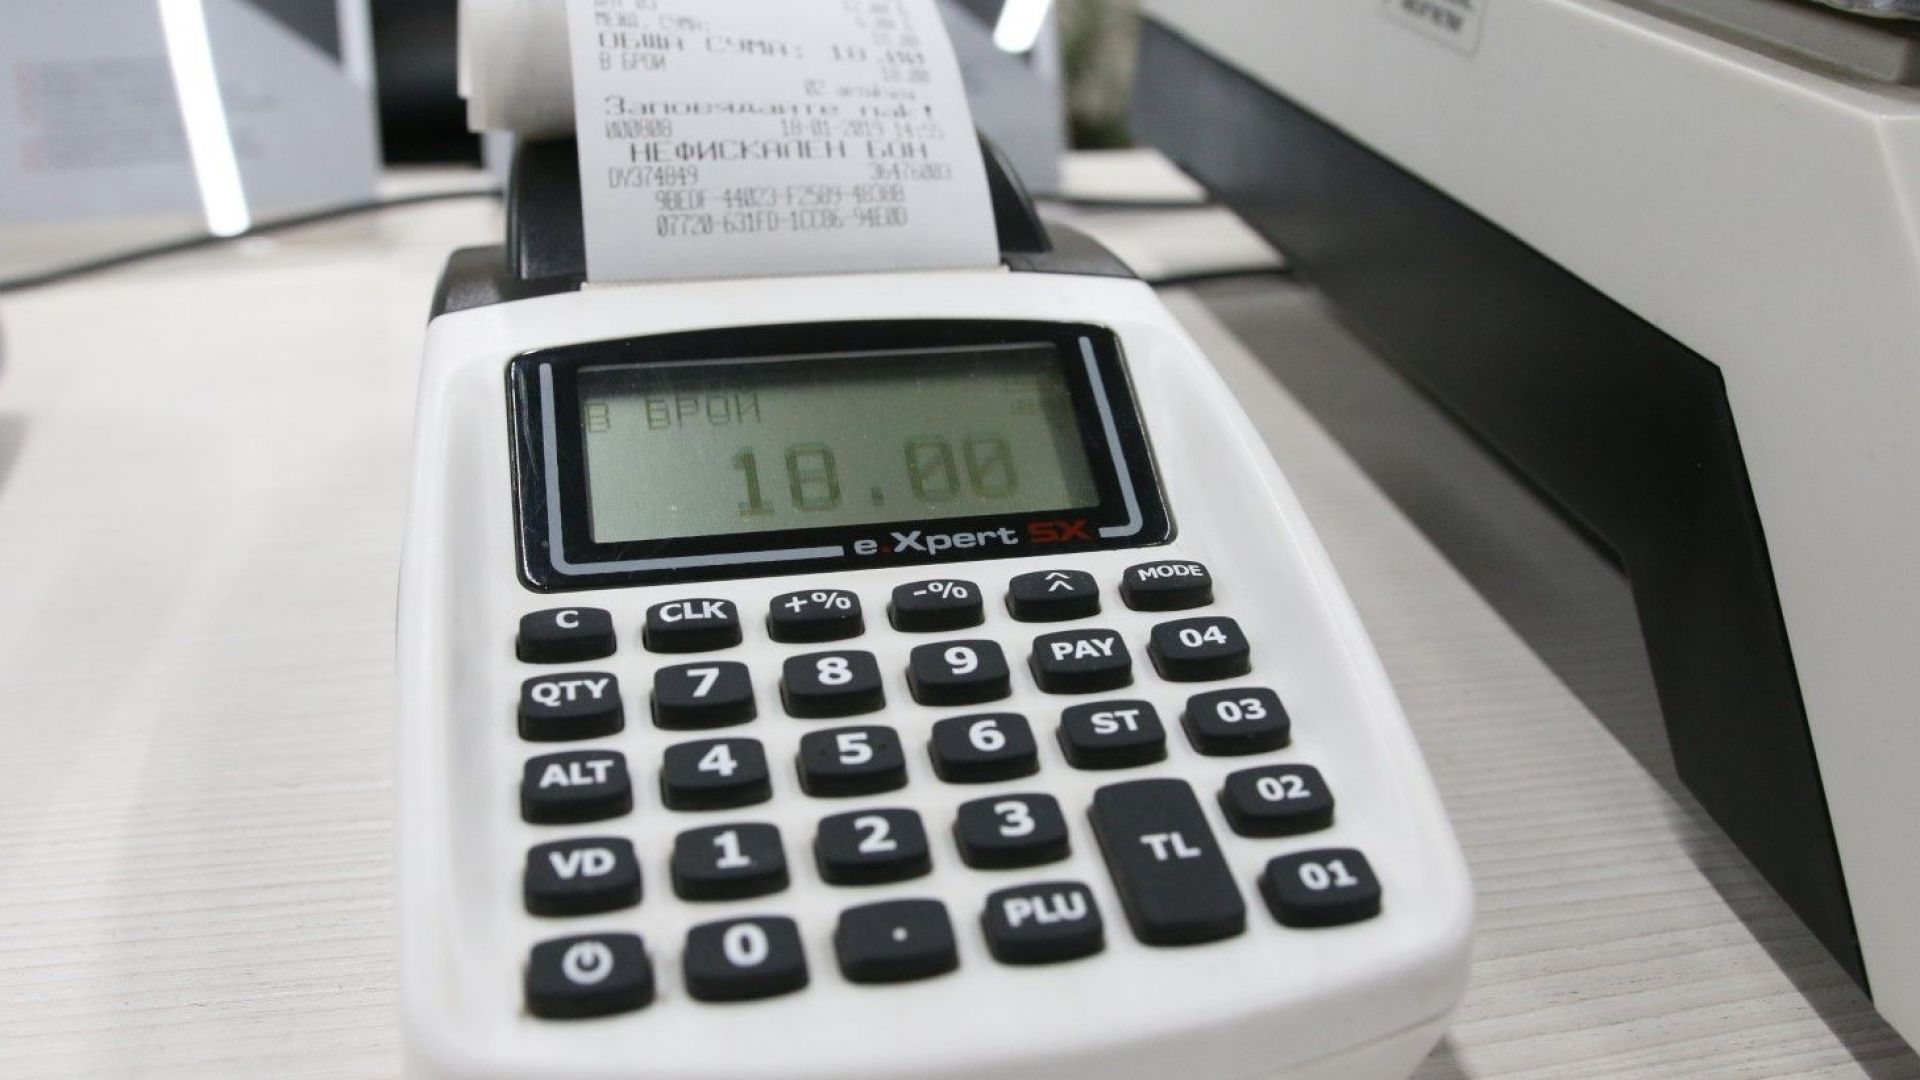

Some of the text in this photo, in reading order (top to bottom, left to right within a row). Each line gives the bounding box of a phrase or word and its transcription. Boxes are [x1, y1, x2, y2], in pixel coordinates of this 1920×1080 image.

[629, 139, 928, 163] НЕФИСКАЛЕН БОН
[586, 401, 611, 433] В
[732, 433, 1020, 519] 18.00
[853, 518, 1092, 556] e.Xpert SX
[1138, 564, 1204, 581] MODE
[555, 610, 579, 628] C
[660, 600, 728, 623] CLK
[1050, 637, 1115, 661] PAY
[1178, 626, 1228, 648] 04
[816, 657, 853, 686] 8
[943, 646, 978, 675] 9
[531, 679, 609, 707] QTY
[686, 668, 720, 698] 7
[1090, 709, 1140, 735] ST
[1216, 697, 1267, 723] 03
[835, 732, 874, 765] 5
[968, 720, 1006, 752] 6
[539, 760, 615, 788] ALT
[698, 744, 738, 776] 4
[1256, 775, 1310, 802] 02
[993, 800, 1036, 837] 3
[854, 815, 897, 853] 2
[1140, 832, 1200, 861] TL
[548, 847, 616, 880] VD
[712, 830, 751, 869] 1
[1299, 859, 1358, 890] 01
[1002, 891, 1089, 928] PLU
[722, 922, 770, 968] 0
